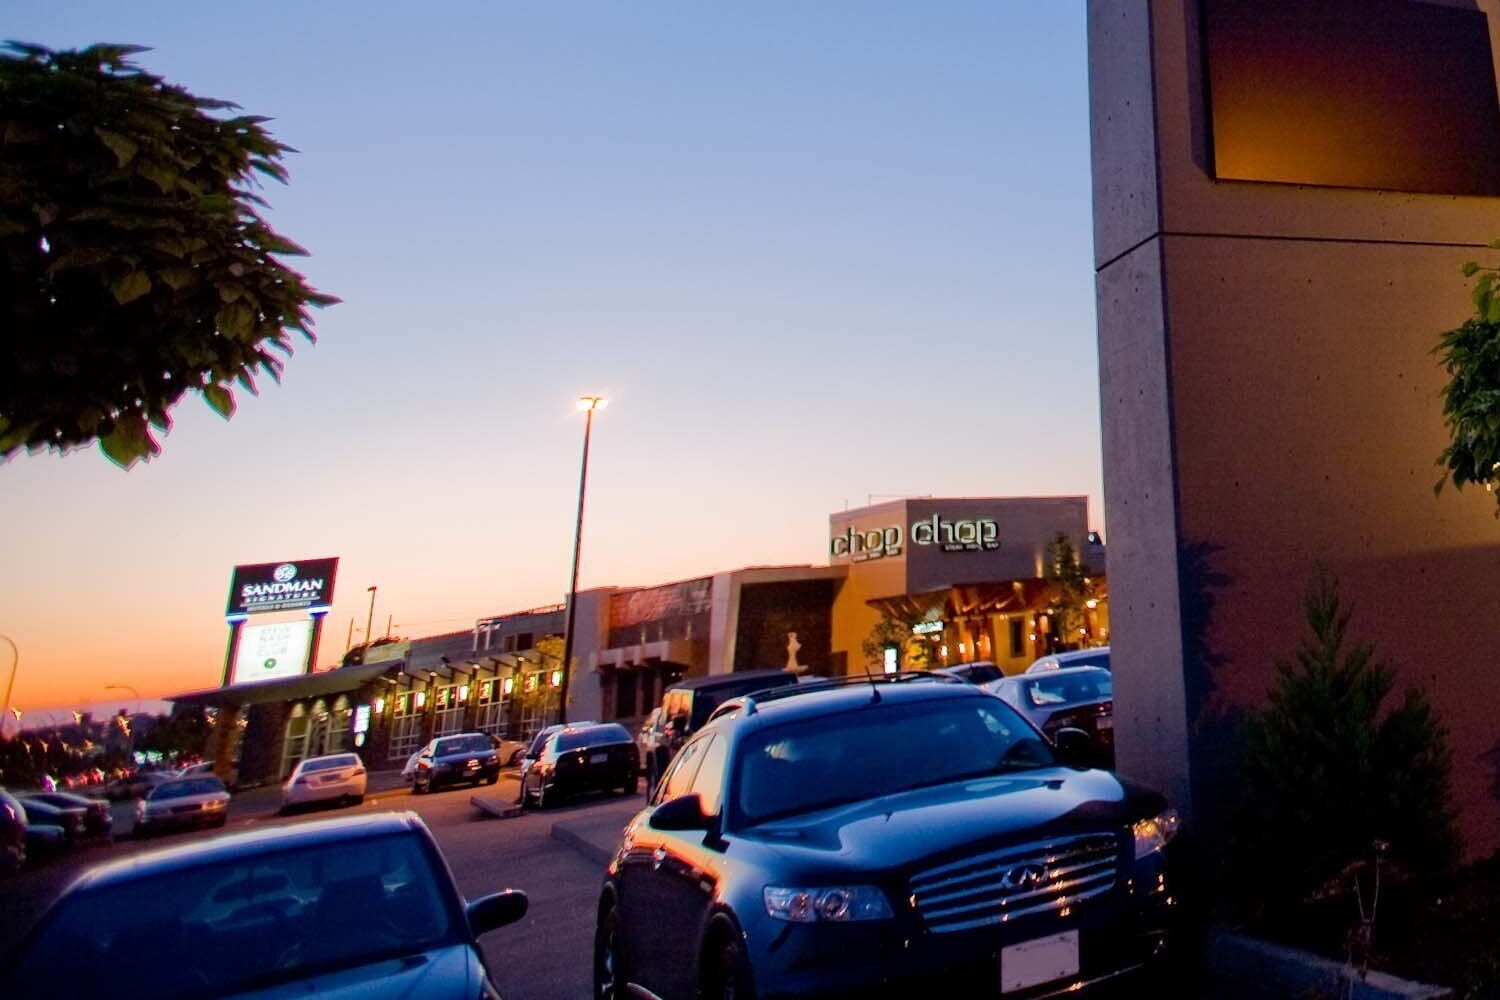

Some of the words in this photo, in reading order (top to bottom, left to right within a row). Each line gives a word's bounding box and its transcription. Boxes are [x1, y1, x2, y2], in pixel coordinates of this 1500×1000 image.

[831, 524, 903, 557] chop
[911, 513, 999, 550] chop
[241, 578, 323, 597] SANDMAN
